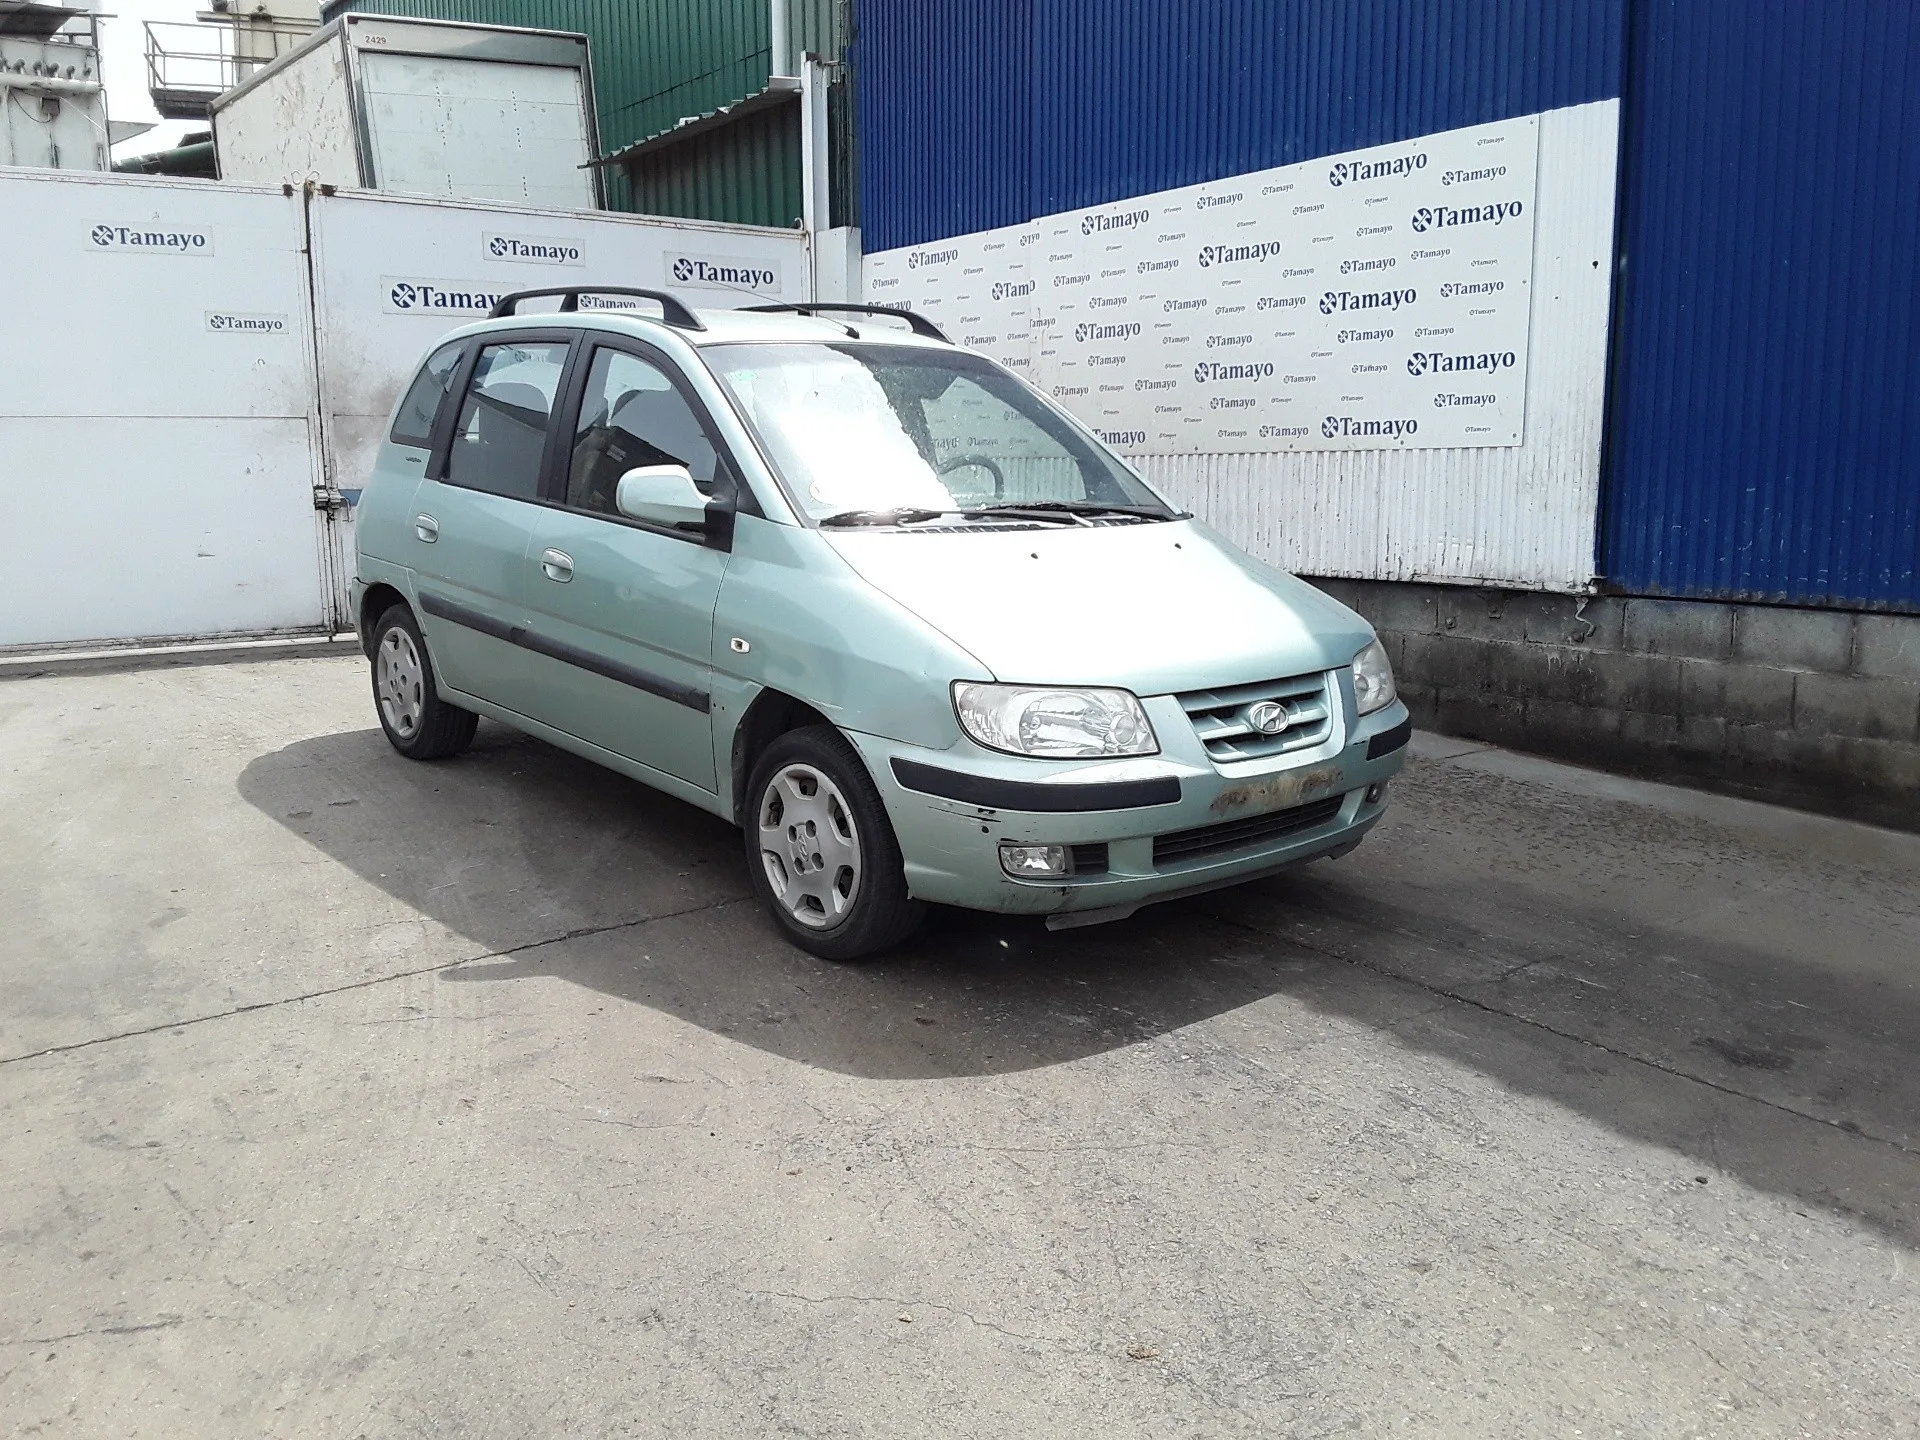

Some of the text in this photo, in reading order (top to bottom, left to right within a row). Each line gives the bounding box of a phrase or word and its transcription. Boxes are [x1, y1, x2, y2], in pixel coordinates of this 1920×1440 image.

[365, 36, 386, 44] 2429
[1483, 136, 1504, 145] Tamayo
[1349, 153, 1427, 182] Tamayo
[1455, 166, 1506, 183] Tamayo
[1269, 183, 1293, 194] Tamayo
[1207, 193, 1243, 207] Tamayo
[1299, 203, 1324, 214] Tamayo
[1434, 200, 1523, 228] Tamayo
[1095, 210, 1149, 232] Tamayo
[1364, 225, 1392, 236] Tamayo
[115, 228, 205, 251] Tamayo
[1164, 233, 1185, 241] Tamayo
[508, 240, 578, 262] Tamayo
[1215, 241, 1280, 263] Tamayo
[1419, 249, 1450, 259] Tamayo
[919, 249, 958, 266] Tamayo
[1146, 259, 1179, 271] Tamayo
[1352, 257, 1396, 272] Tamayo
[694, 262, 774, 288] Tamayo
[1289, 267, 1314, 277] Tamayo
[1061, 274, 1090, 285] Tamayo
[1453, 281, 1504, 295] Tamayo
[417, 287, 501, 309] Tamay
[1097, 297, 1127, 308] Tamayo
[1267, 296, 1306, 309] Tamayo
[1338, 288, 1417, 311] Tamayo
[1173, 299, 1207, 311] Tamayo
[1221, 305, 1245, 314] Tamayo
[225, 317, 282, 332] Tamayo
[1088, 323, 1140, 341] Tamayo
[1350, 329, 1394, 342] Tamayo
[1423, 327, 1454, 336] Tamayo
[971, 336, 996, 346] Tamayo
[1216, 335, 1252, 347] Tamayo
[1009, 358, 1031, 367] Tamay
[1095, 356, 1125, 366] Tamayo
[1429, 351, 1515, 374] Tamayo
[1210, 362, 1274, 382] Tamayo
[1359, 364, 1388, 374] Tamayo
[1143, 379, 1176, 390] Tamayo
[1290, 375, 1316, 383] Tamayo
[1061, 386, 1088, 396] Tamayo
[1219, 398, 1255, 409] Tamayo
[1446, 394, 1496, 407] Tamayo
[1223, 430, 1247, 438] Tamayo
[1269, 426, 1309, 439] Tamayo
[1340, 418, 1418, 439] Tamayo
